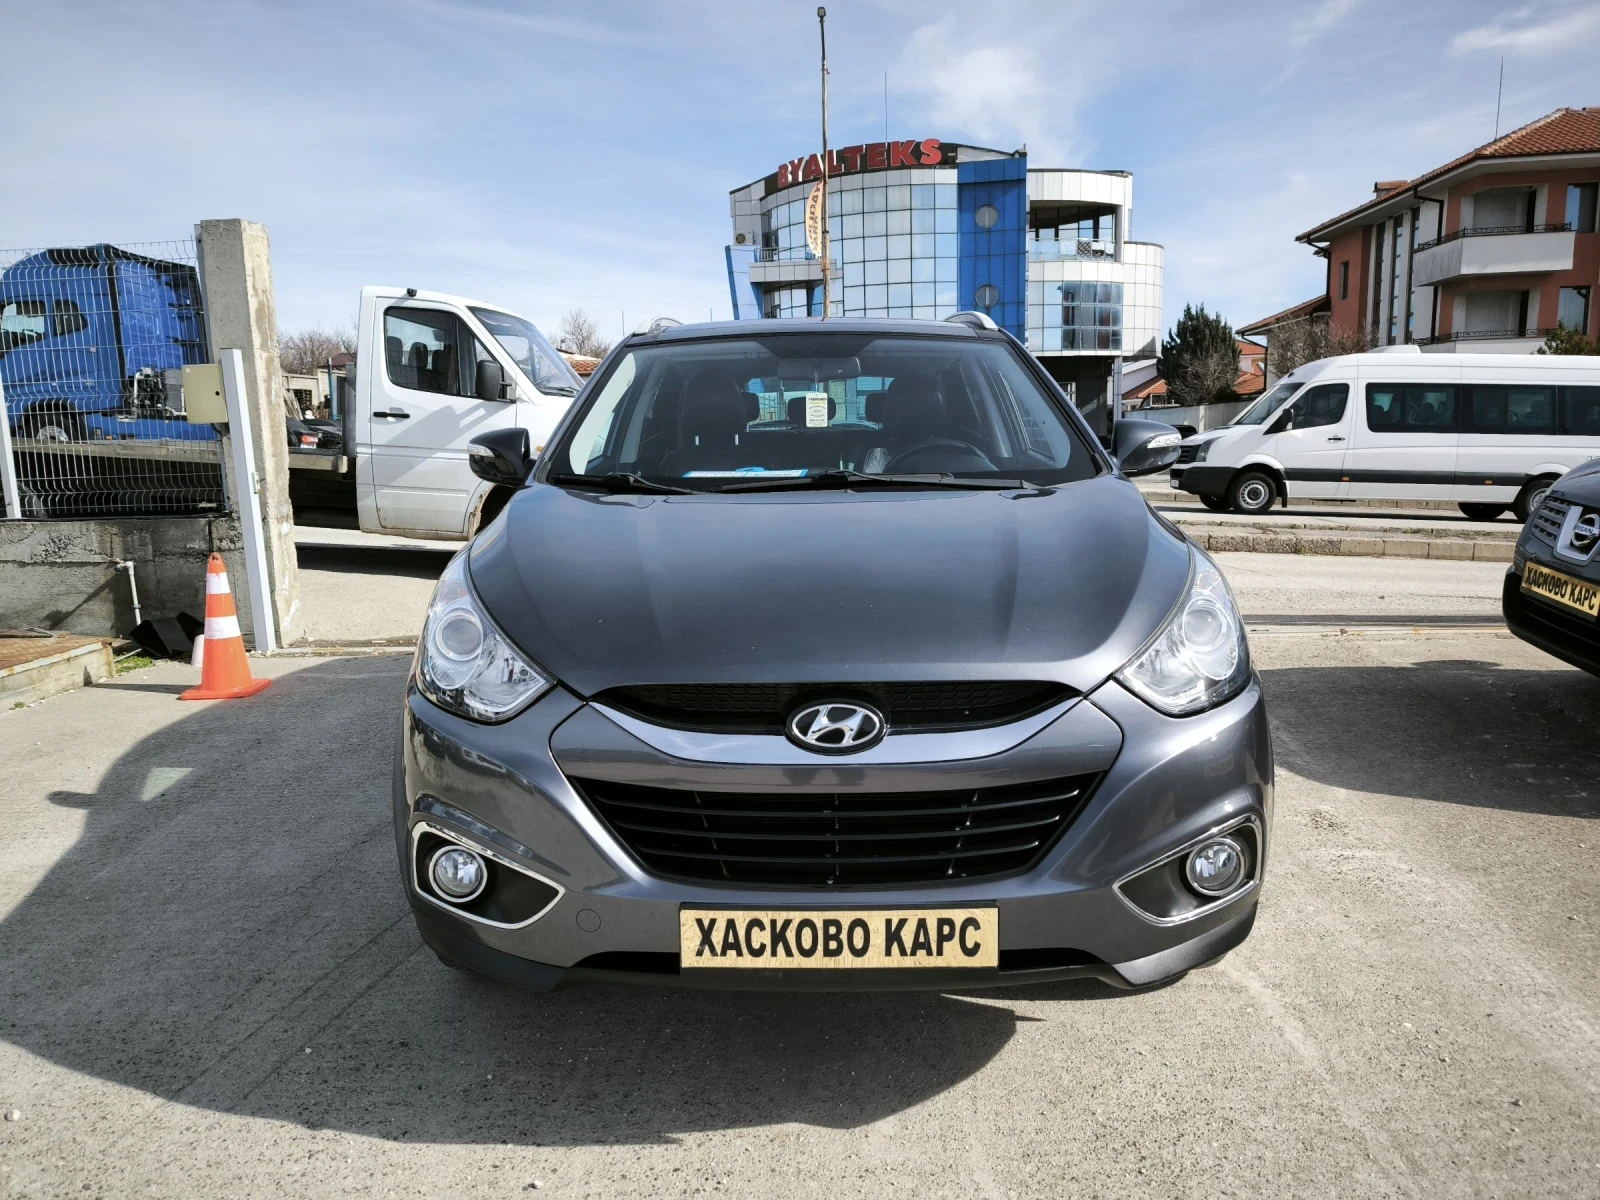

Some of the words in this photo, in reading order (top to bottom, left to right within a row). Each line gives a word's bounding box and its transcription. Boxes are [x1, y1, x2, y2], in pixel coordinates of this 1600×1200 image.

[777, 138, 942, 188] BYALTEKS
[1525, 566, 1569, 599] ХАСКОВО
[1568, 582, 1597, 611] КАРС
[695, 917, 871, 958] ХАСКОВО
[884, 917, 982, 957] КАРС
